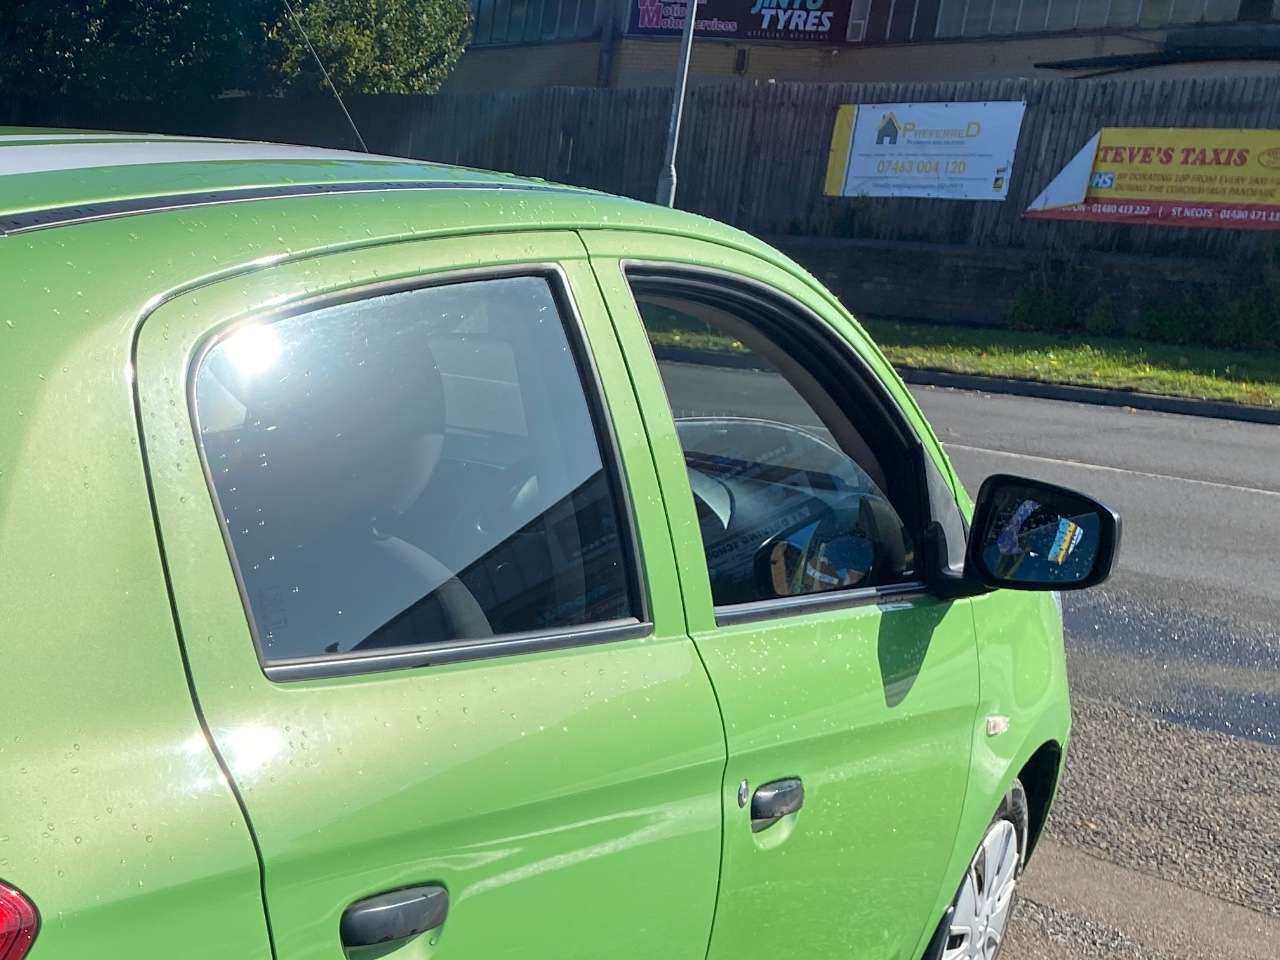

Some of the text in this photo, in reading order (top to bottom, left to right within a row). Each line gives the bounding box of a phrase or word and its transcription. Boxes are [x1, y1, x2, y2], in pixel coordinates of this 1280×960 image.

[760, 9, 833, 31] TYRES
[1099, 145, 1174, 165] TEVE'S
[1180, 148, 1250, 166] TAXIS
